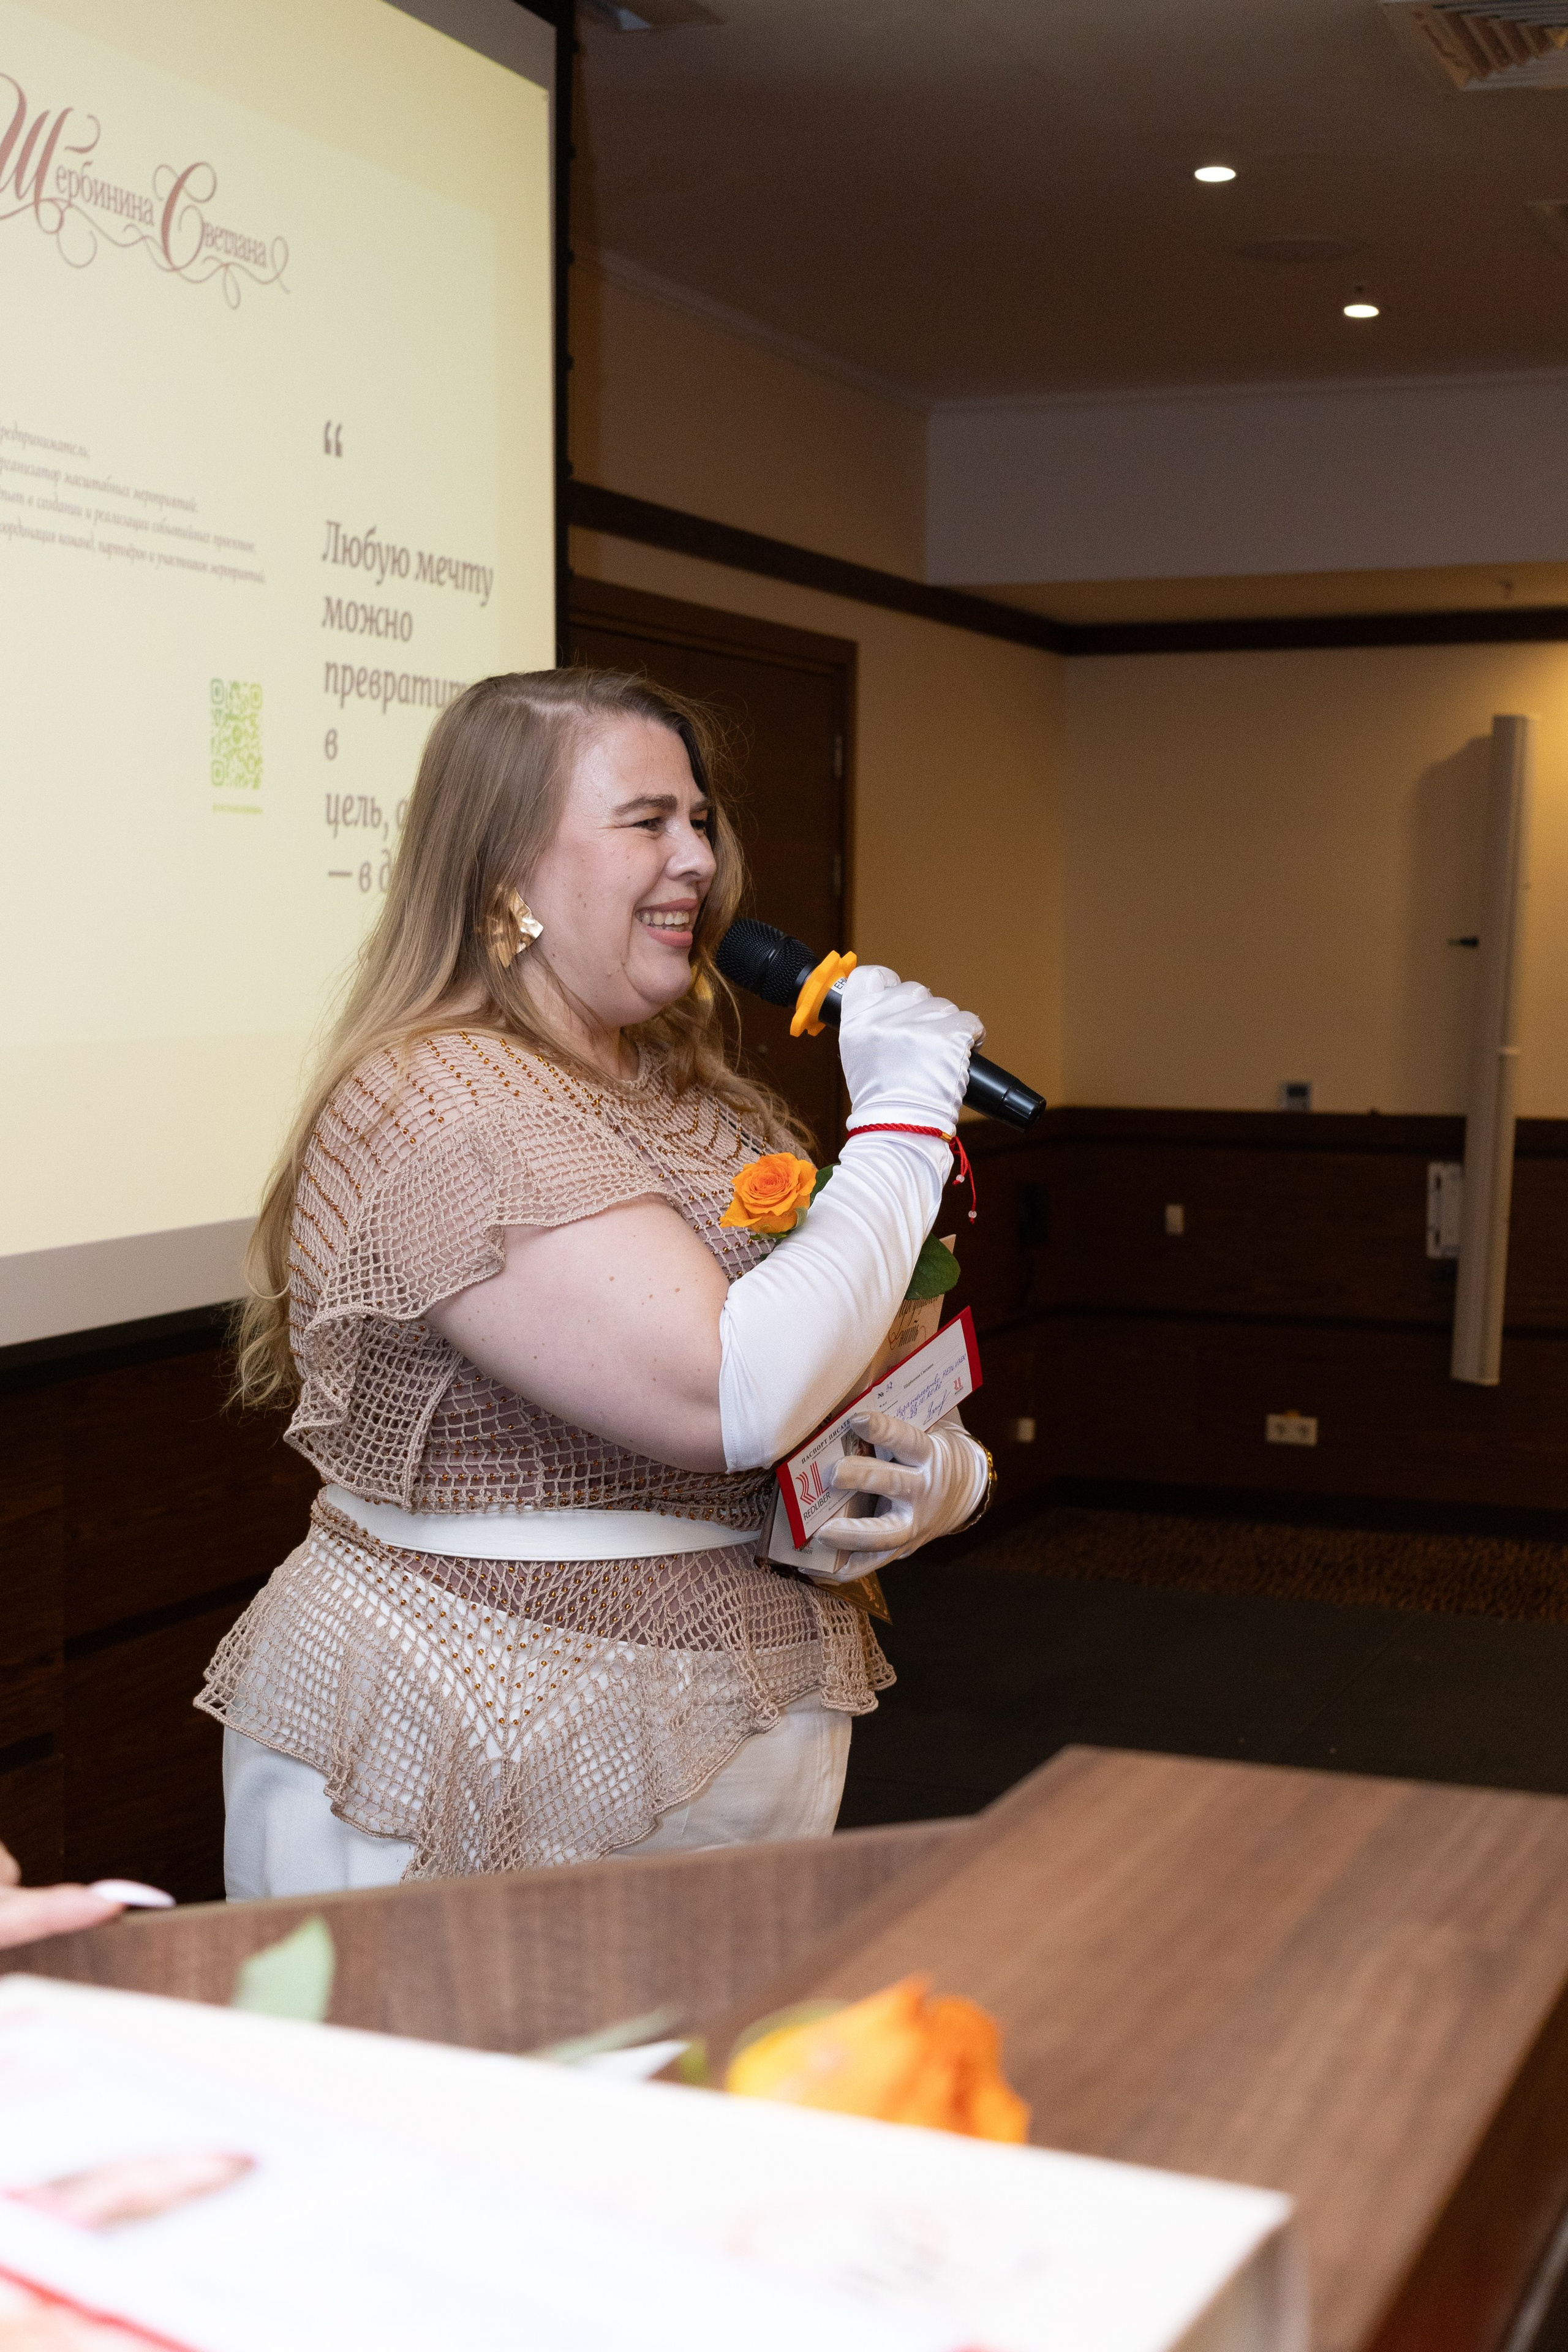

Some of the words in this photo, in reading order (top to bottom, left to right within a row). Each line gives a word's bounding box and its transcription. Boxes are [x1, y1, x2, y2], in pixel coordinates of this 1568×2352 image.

[322, 519, 411, 586] Любую
[415, 551, 494, 608] мечту
[322, 595, 413, 642] можно
[324, 728, 338, 760] в
[326, 793, 389, 841] цель,
[359, 861, 371, 893] в
[801, 1438, 827, 1464] ПАСПОРТ
[828, 1416, 853, 1441] ПИСАТЕ
[803, 1491, 831, 1521] REDLIBER
